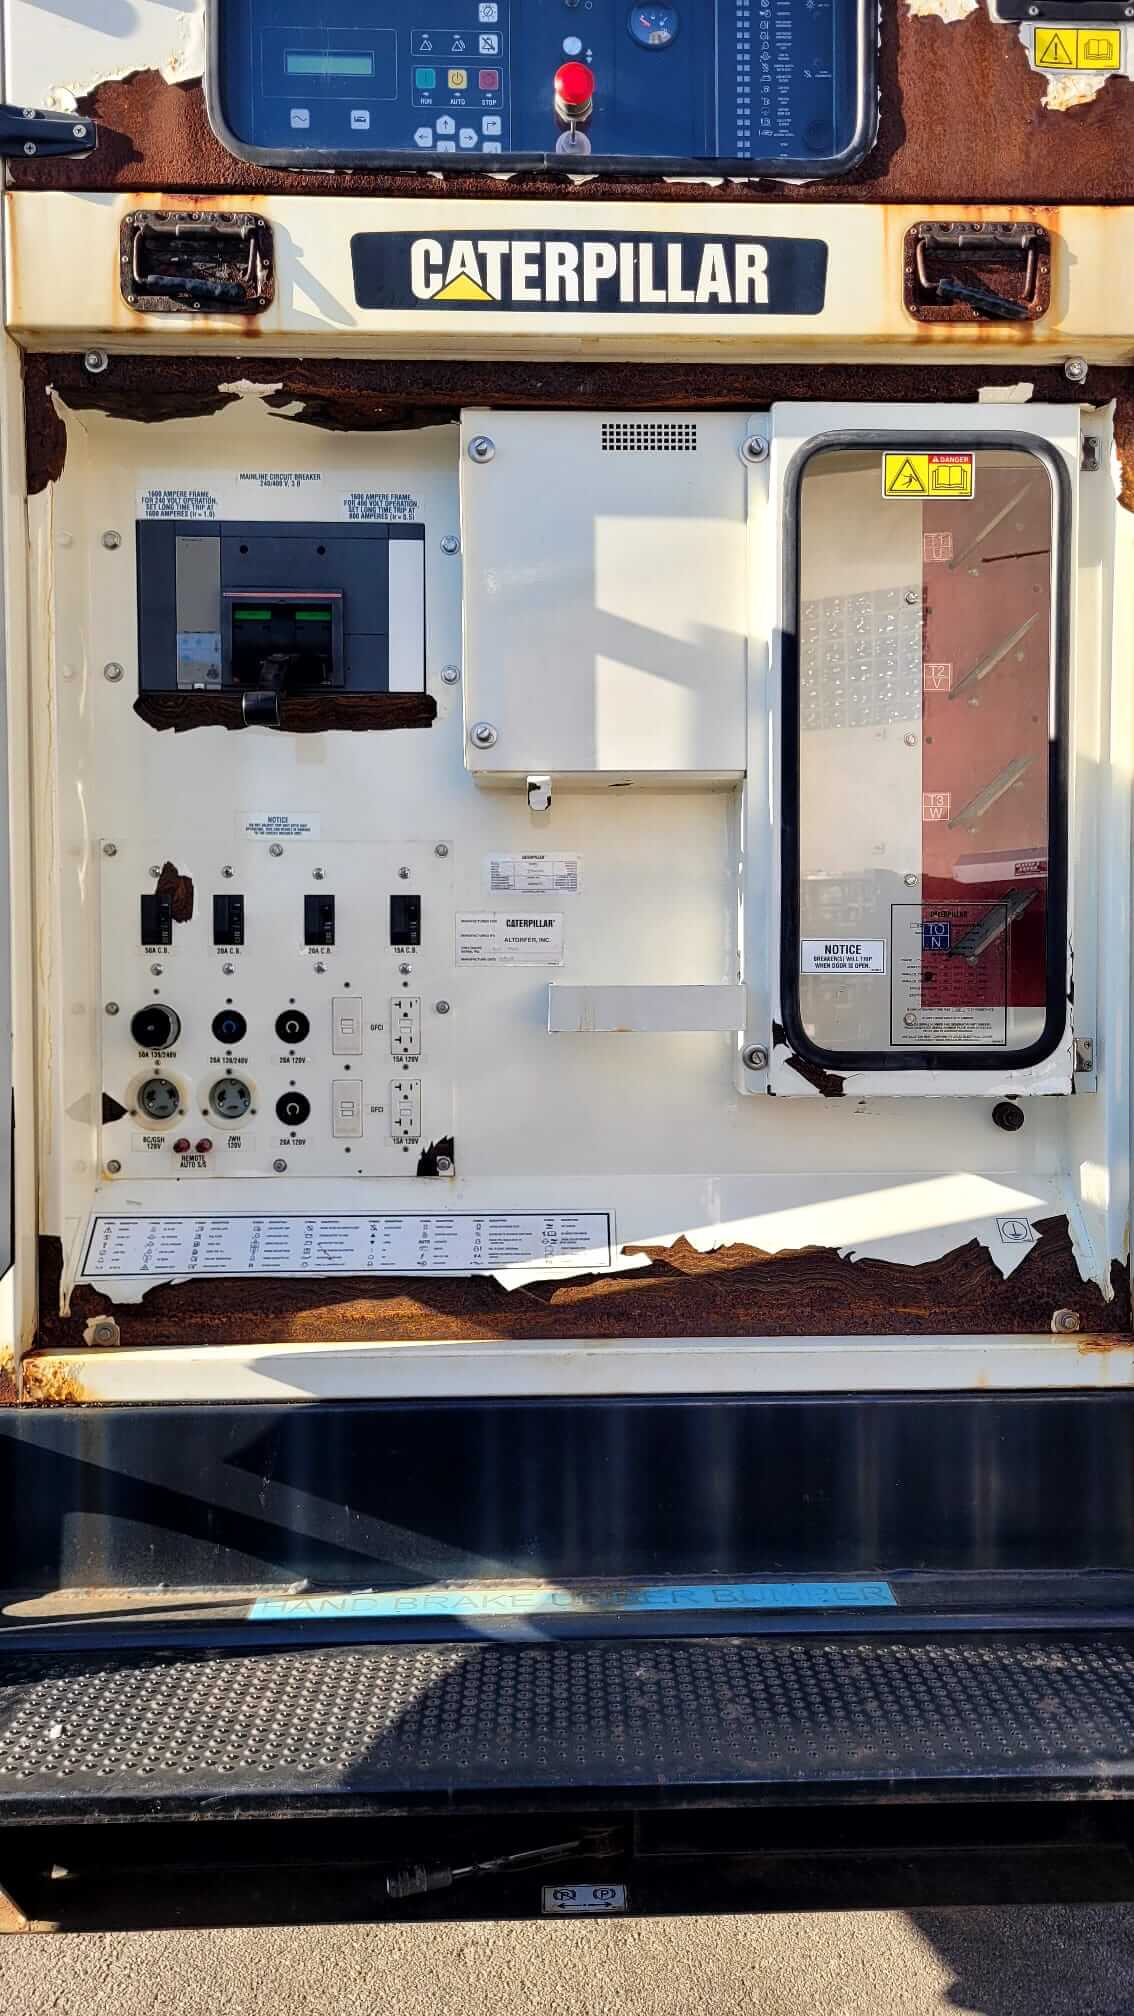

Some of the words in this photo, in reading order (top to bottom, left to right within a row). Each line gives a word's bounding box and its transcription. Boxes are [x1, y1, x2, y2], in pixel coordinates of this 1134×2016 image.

[410, 238, 769, 304] CATERPILLAR
[928, 666, 945, 677] T2
[933, 678, 942, 689] V
[928, 794, 944, 806] T3
[930, 807, 943, 819] W
[506, 919, 553, 927] CATERPILLAR
[931, 937, 941, 948] N
[824, 944, 862, 955] NOTICE
[292, 1138, 306, 1146] 120V
[262, 1595, 378, 1614] HAND
[392, 1591, 538, 1610] BRAKE
[711, 1585, 890, 1603] BUMPER
